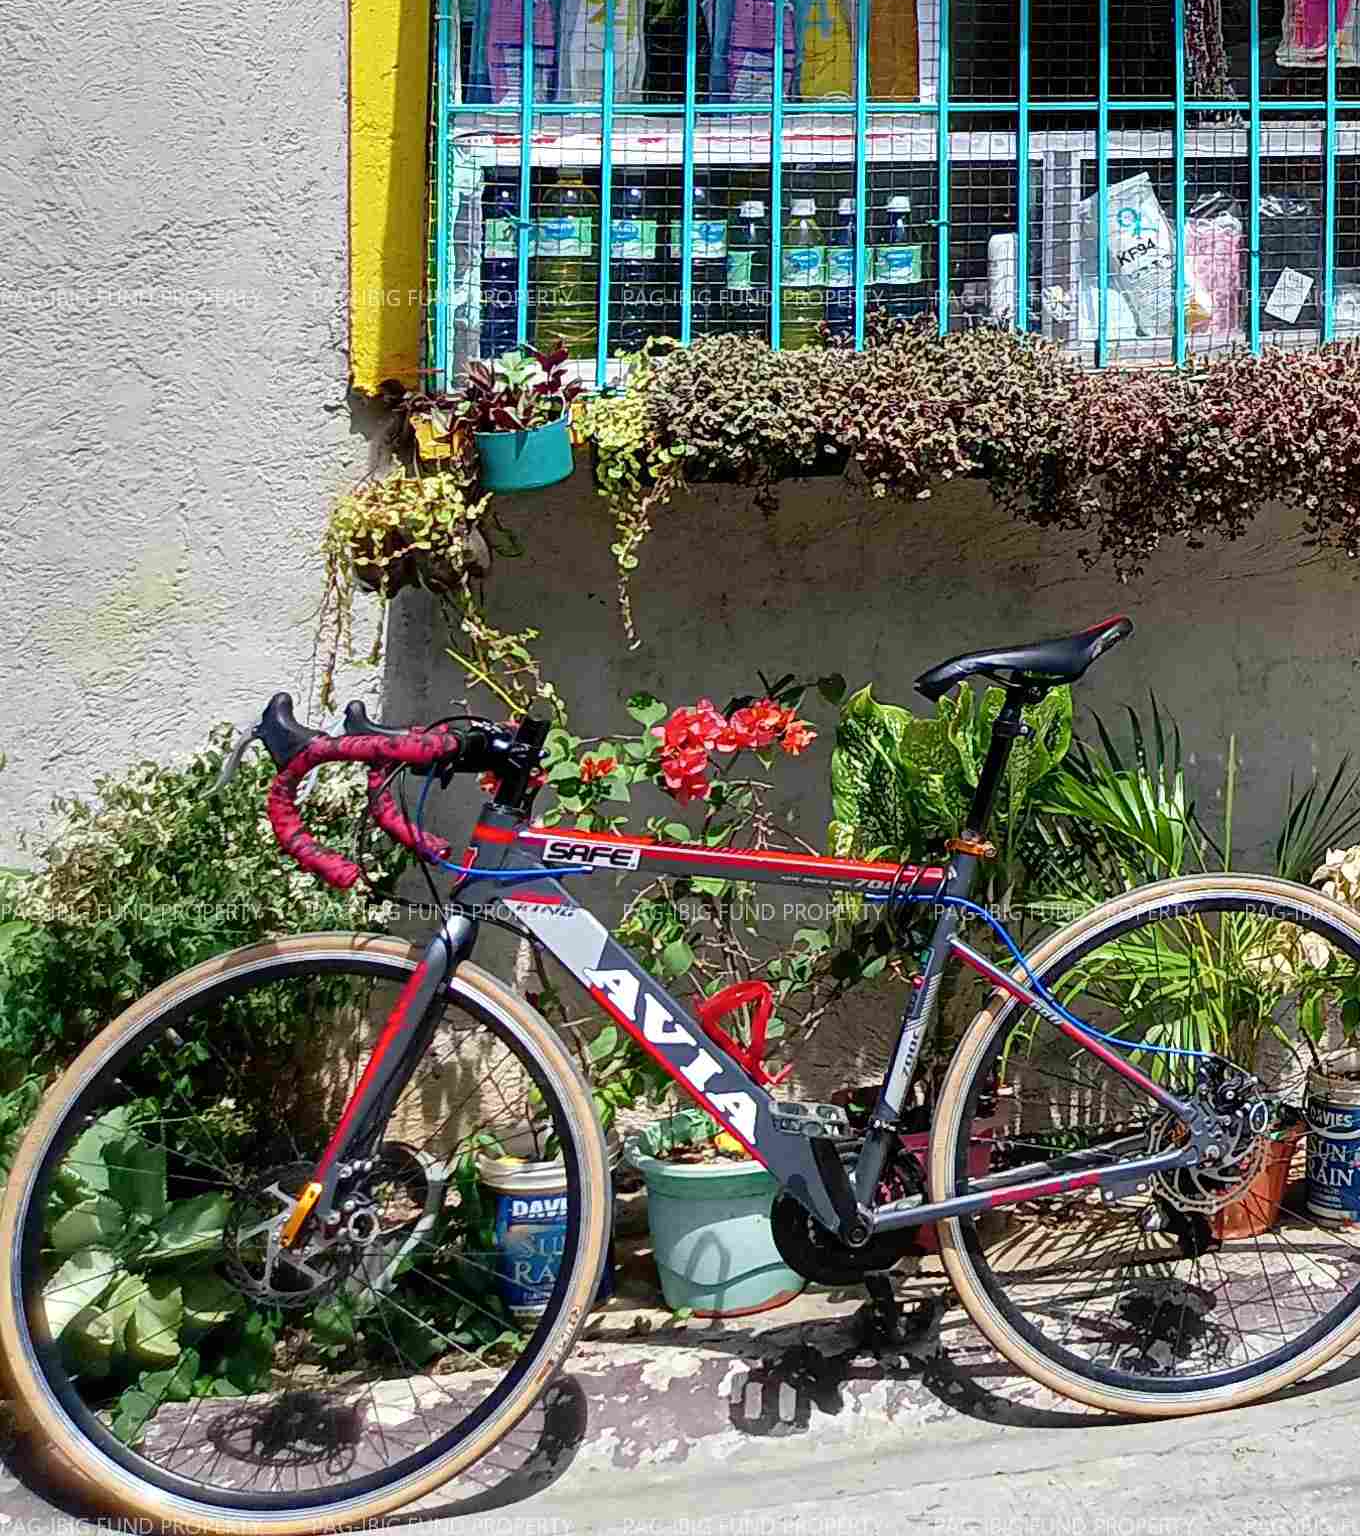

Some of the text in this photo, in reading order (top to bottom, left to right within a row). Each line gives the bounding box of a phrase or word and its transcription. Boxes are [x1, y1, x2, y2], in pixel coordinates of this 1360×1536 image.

[1116, 238, 1157, 267] KF94
[547, 842, 634, 867] SAFE
[583, 967, 758, 1146] AVIA
[1310, 1106, 1353, 1127] DAVIES
[1307, 1134, 1348, 1162] SUN
[511, 1197, 568, 1218] DAVI
[512, 1261, 557, 1284] RA
